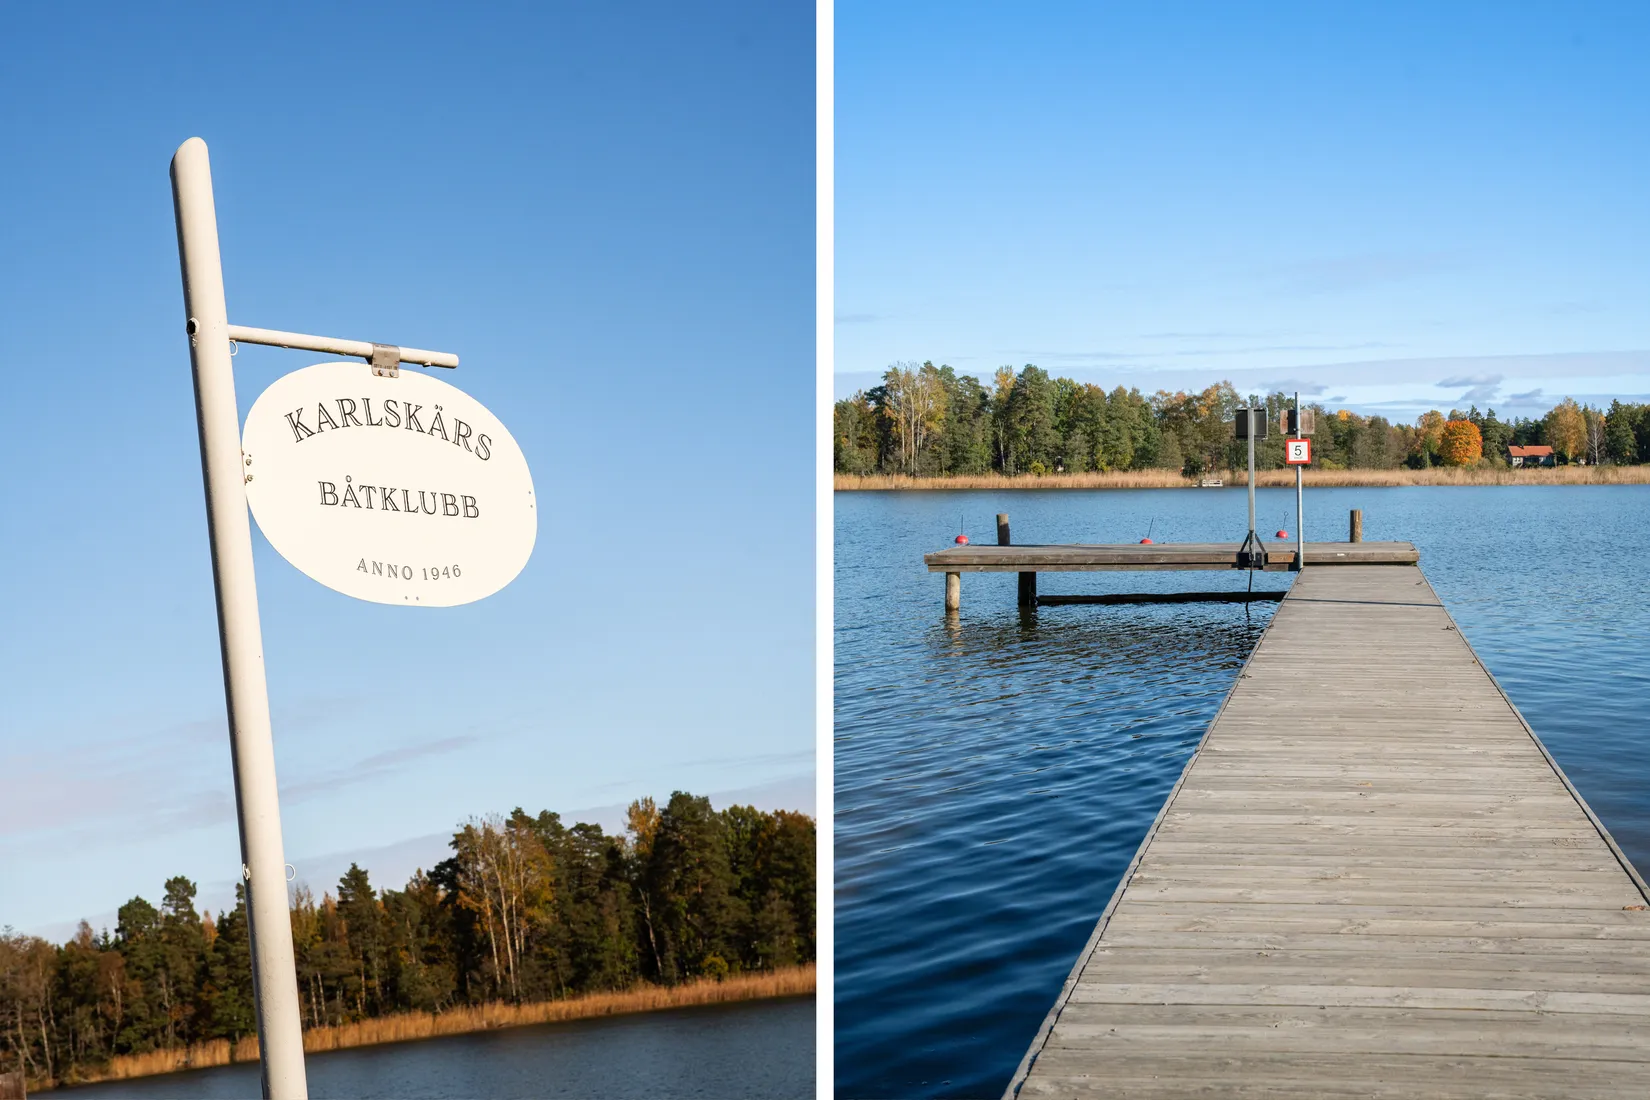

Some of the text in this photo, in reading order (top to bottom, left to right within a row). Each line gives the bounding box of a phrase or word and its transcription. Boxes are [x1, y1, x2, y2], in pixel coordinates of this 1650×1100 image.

[284, 397, 492, 461] KARLSKÄRS
[1294, 445, 1302, 456] 5
[318, 475, 479, 518] BÅTKLUBB
[357, 558, 462, 581] ANNO 1946
